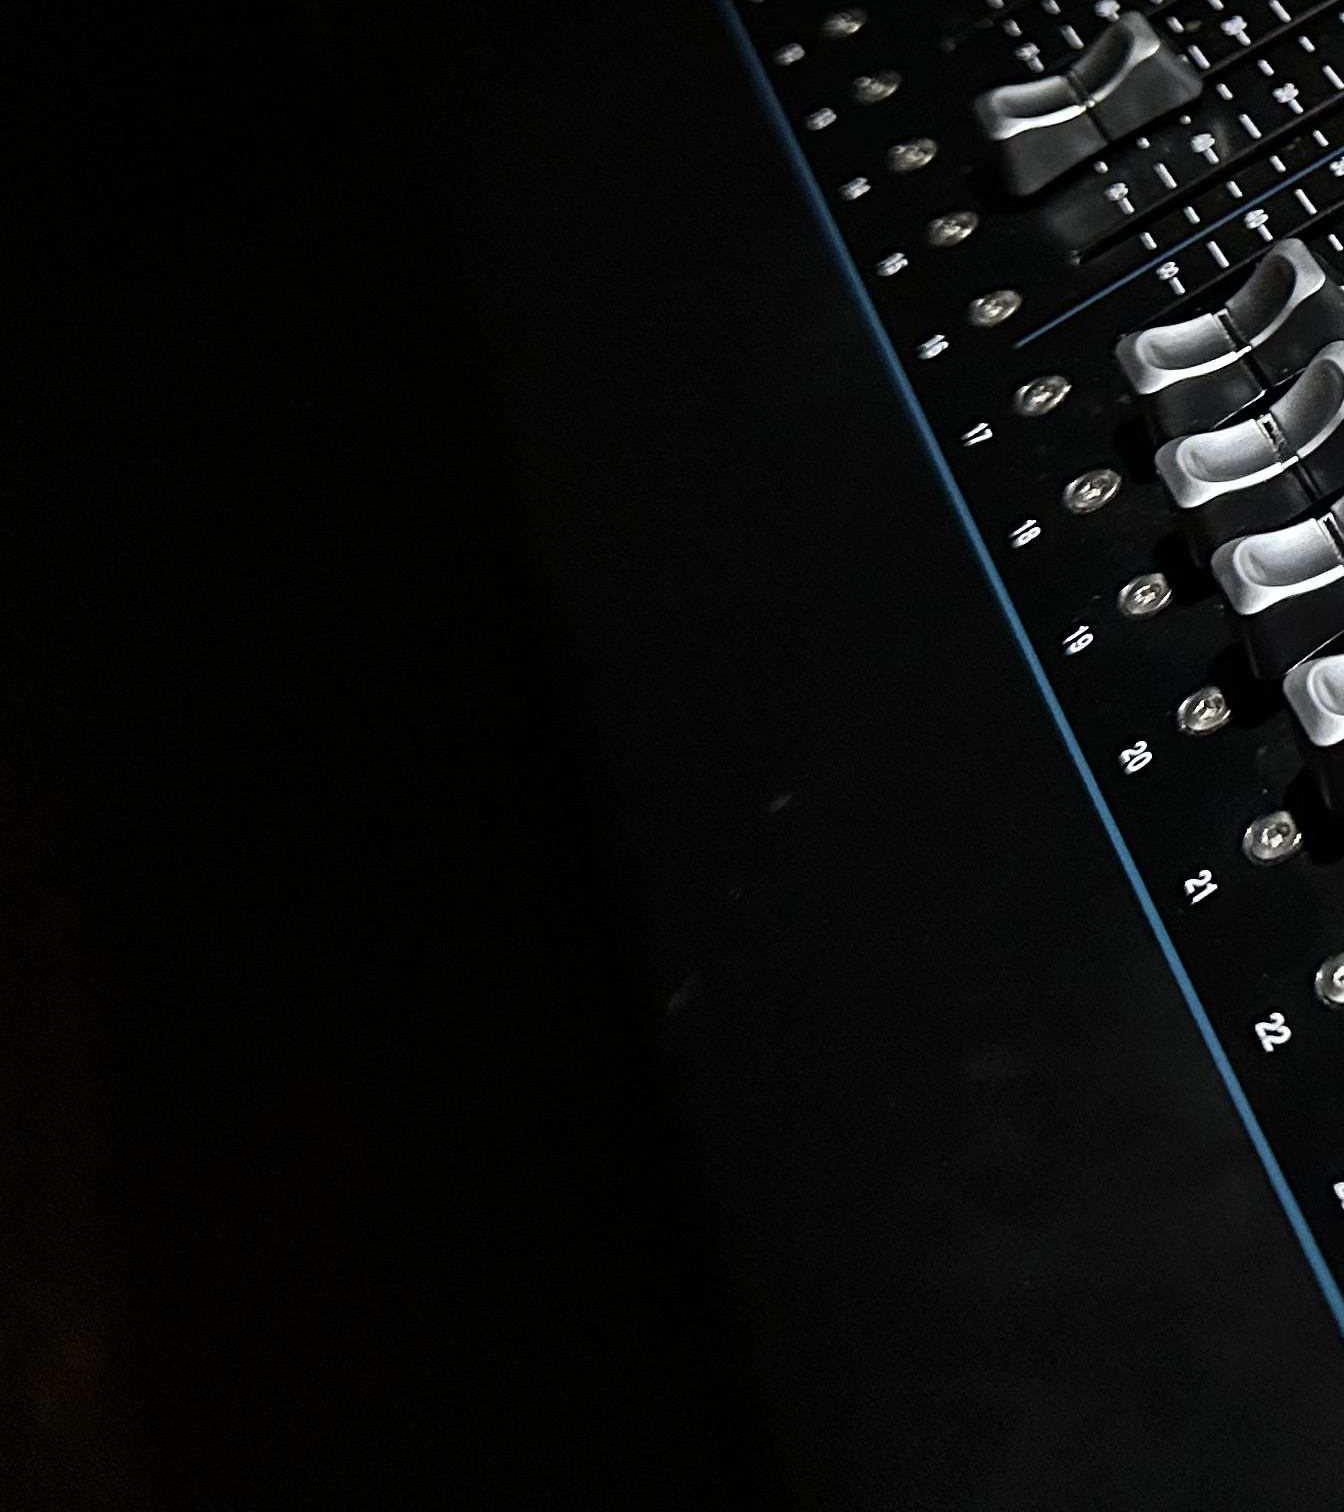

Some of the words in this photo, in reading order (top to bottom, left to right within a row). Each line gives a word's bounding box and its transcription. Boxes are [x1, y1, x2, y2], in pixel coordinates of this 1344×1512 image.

[960, 421, 994, 449] 17
[1008, 518, 1043, 550] 18
[1061, 623, 1095, 656] 19
[1118, 739, 1154, 777] 20
[1183, 868, 1219, 907] 21
[1254, 1011, 1292, 1053] 22
